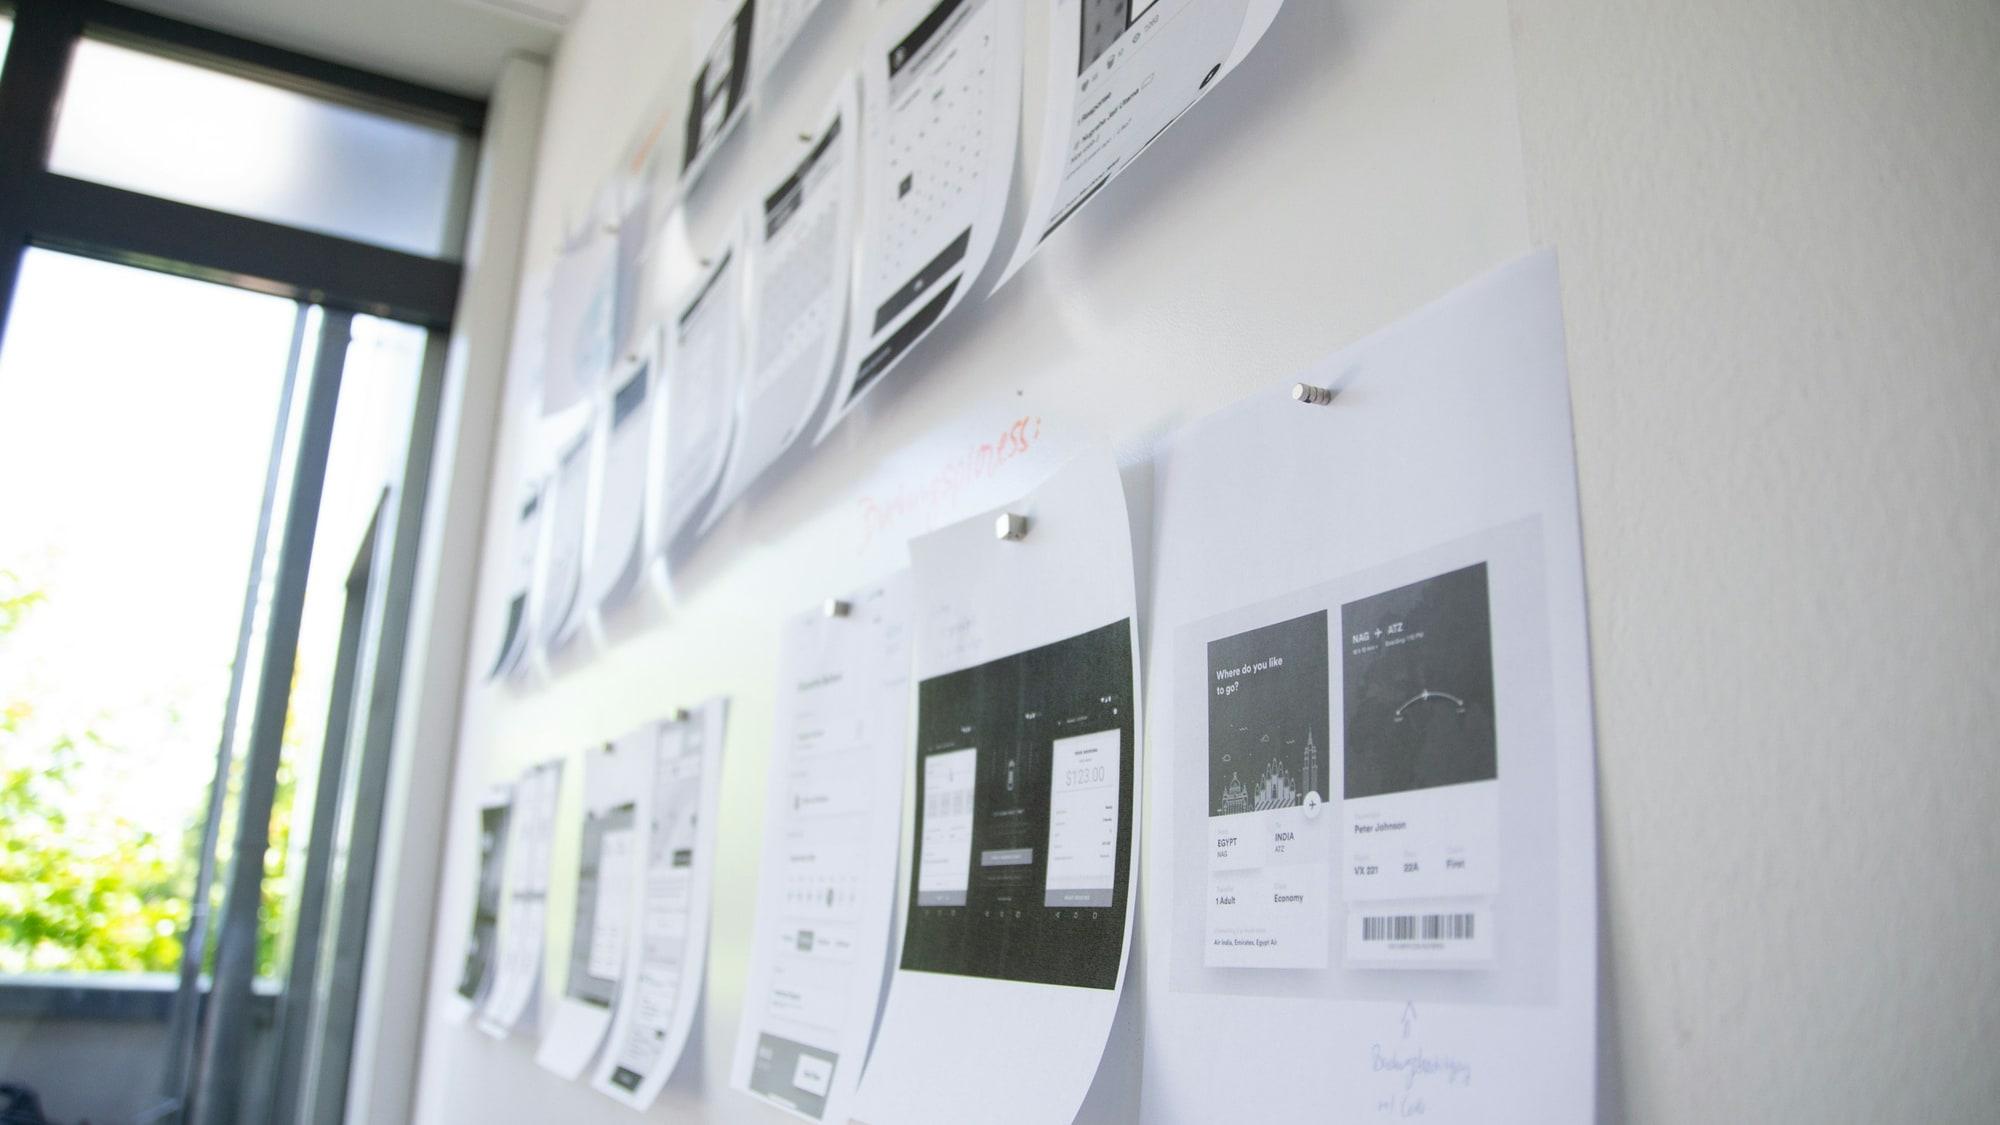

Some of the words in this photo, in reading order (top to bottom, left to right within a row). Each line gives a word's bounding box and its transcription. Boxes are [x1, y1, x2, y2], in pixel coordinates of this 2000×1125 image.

[1352, 631, 1370, 644] NAG
[1387, 622, 1404, 635] ATZ
[1216, 669, 1240, 680] Where
[1242, 664, 1251, 675] do
[1253, 661, 1268, 674] you
[1269, 657, 1283, 668] like
[1216, 686, 1225, 696] to
[1226, 681, 1239, 696] go?
[1354, 823, 1374, 834] Peter
[1375, 821, 1407, 832] Johnson
[1275, 831, 1294, 842] INDIA
[1217, 837, 1237, 848] EGYPT
[1217, 850, 1228, 859] NAG
[1274, 845, 1285, 853] ATZ
[1354, 866, 1366, 876] VX
[1219, 896, 1236, 905] Adult
[1274, 893, 1304, 904] Economy
[1214, 938, 1222, 946] Air
[1255, 938, 1270, 948] Egypt
